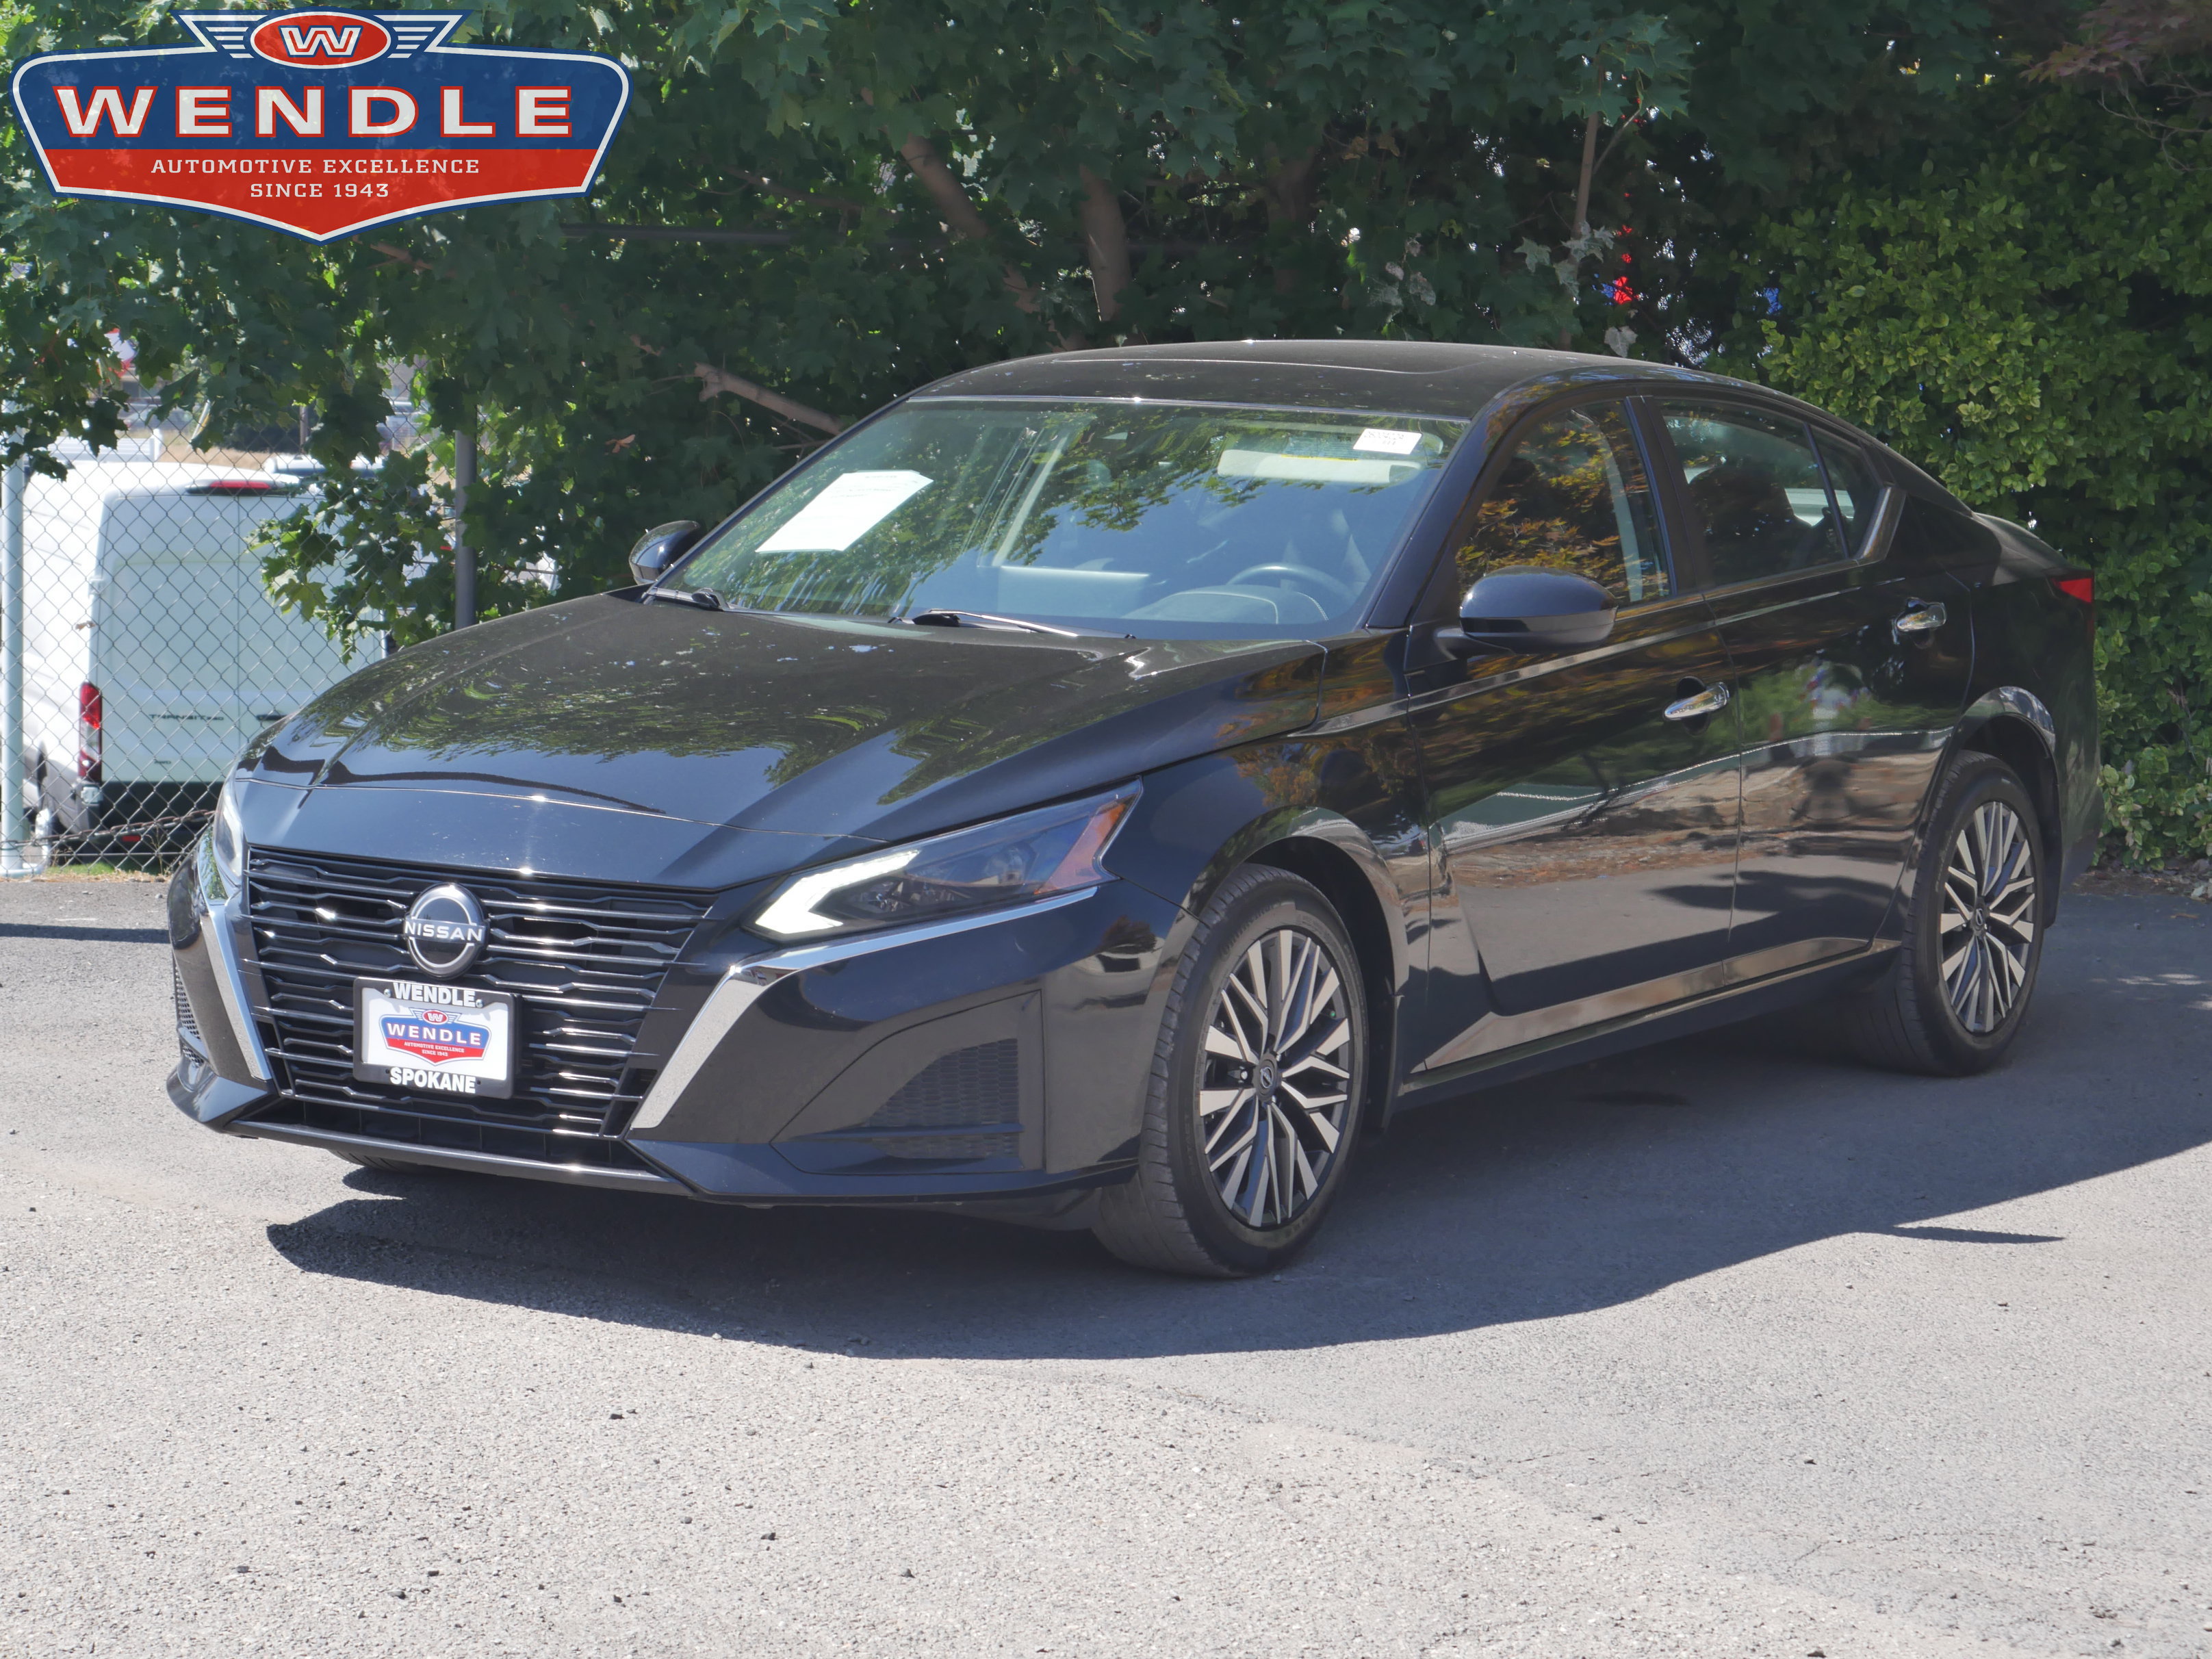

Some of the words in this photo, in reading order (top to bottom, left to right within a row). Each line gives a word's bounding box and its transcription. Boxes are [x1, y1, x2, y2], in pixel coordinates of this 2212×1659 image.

[404, 921, 483, 941] NISSAN
[393, 982, 476, 1007] WENDLE
[387, 1023, 481, 1046] WENDLE
[404, 1041, 435, 1050] AUTOMOTIVE
[435, 1044, 465, 1053] EXCELLENCE
[389, 1067, 476, 1094] SPOKANE
